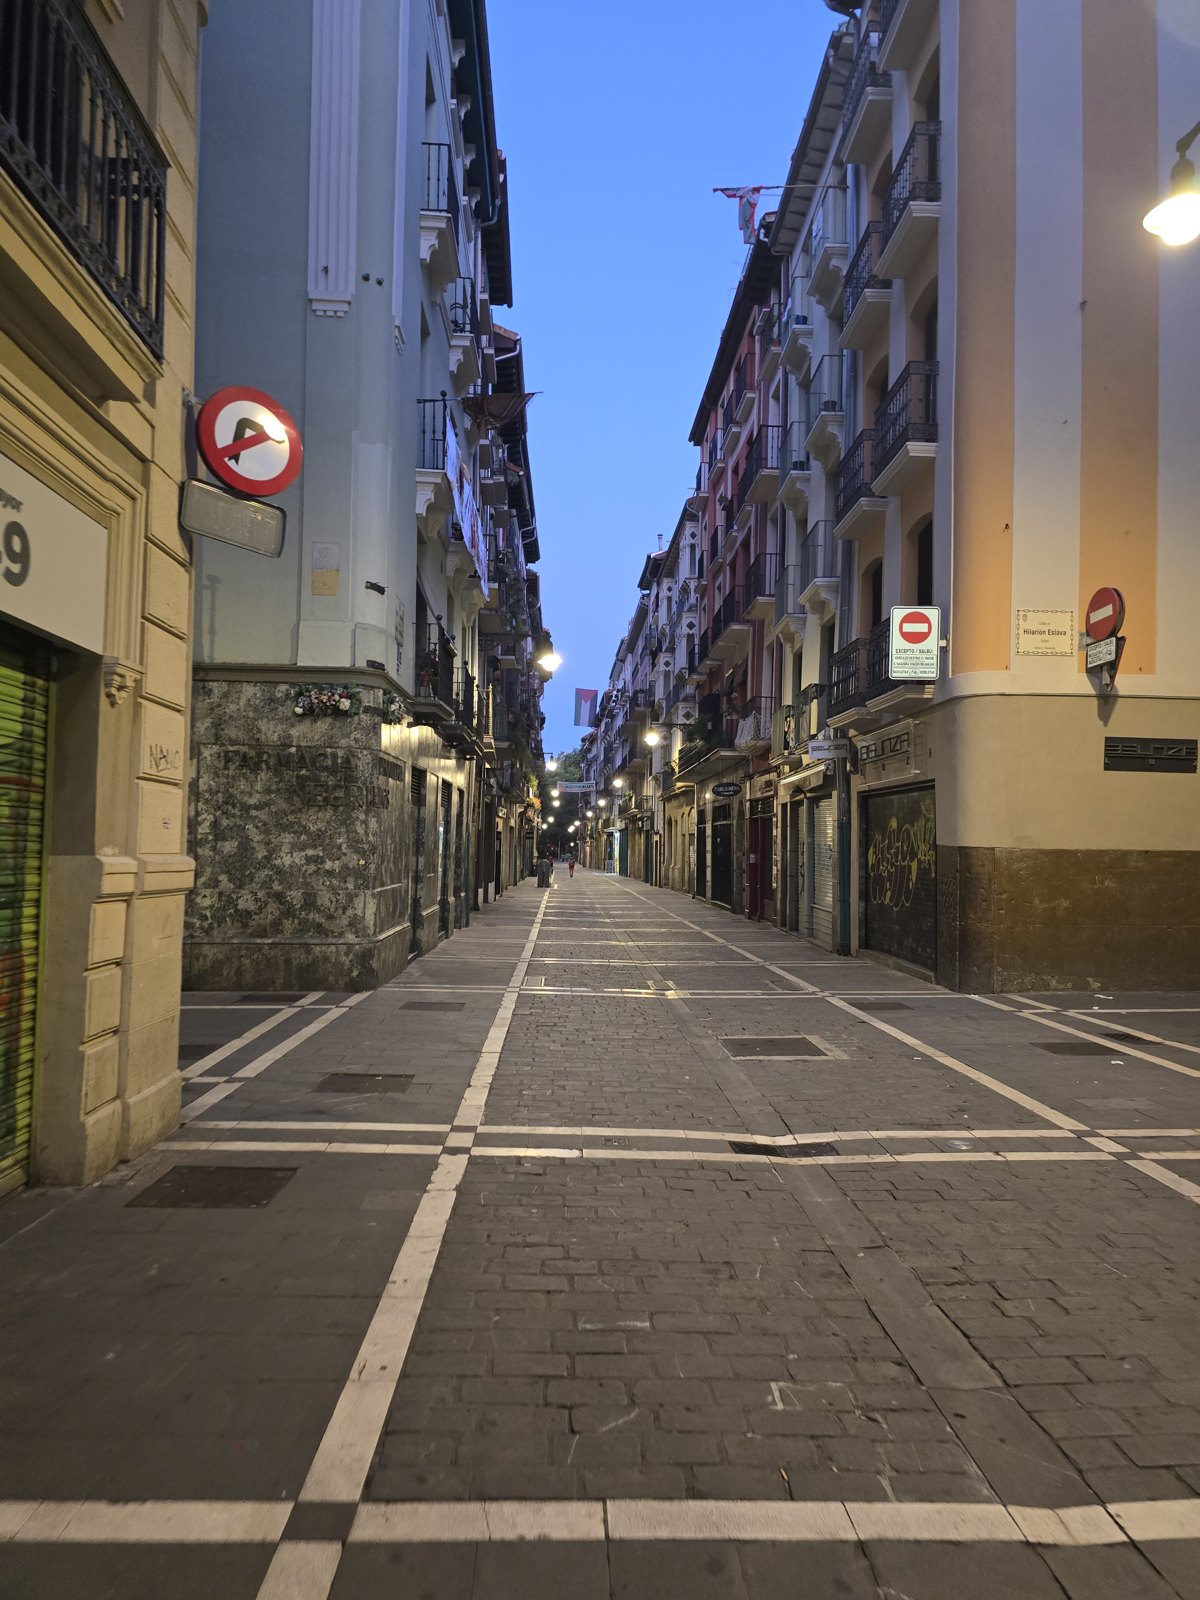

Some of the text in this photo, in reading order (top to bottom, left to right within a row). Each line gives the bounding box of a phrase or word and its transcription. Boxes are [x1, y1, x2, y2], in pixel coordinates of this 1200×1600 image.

[0, 520, 31, 588] 9
[1023, 628, 1067, 636] Hilarión Eslava
[223, 749, 355, 772] FARMACIA
